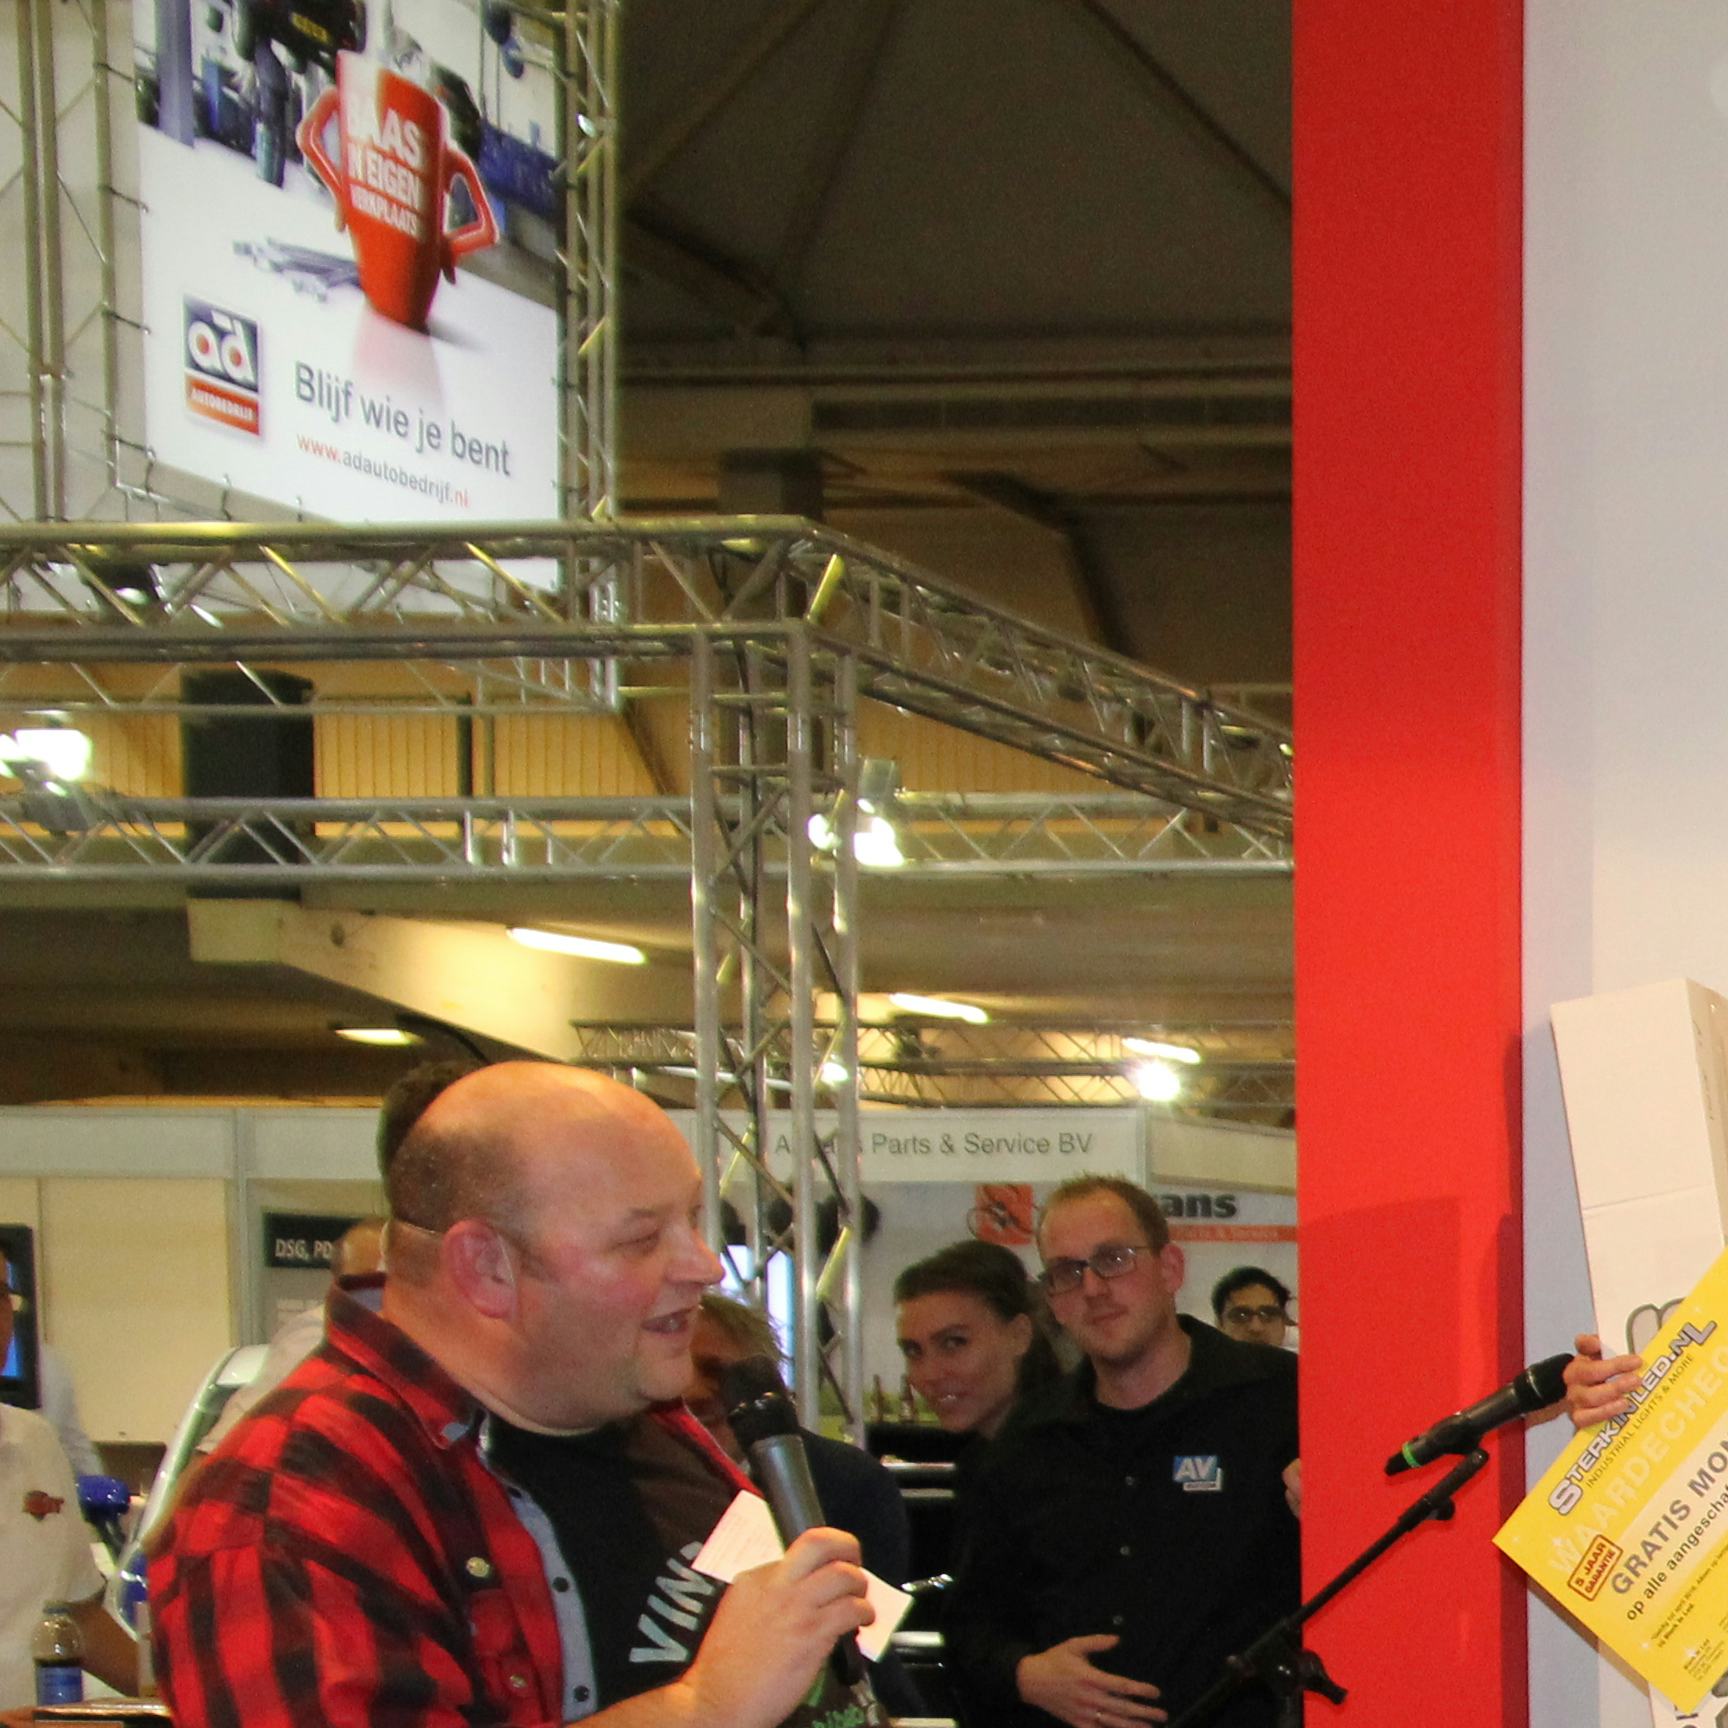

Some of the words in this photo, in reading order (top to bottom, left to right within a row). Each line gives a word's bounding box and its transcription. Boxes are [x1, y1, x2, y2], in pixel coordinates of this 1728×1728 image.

[295, 361, 353, 423] Blijf
[361, 396, 408, 438] wie
[416, 410, 441, 453] je
[451, 422, 511, 476] bent
[297, 434, 469, 508] www.adautobedrijf.nl
[872, 1133, 931, 1155] Parts
[940, 1134, 955, 1155] &
[964, 1133, 1050, 1155] Service
[1059, 1133, 1093, 1155] BV
[1154, 1192, 1238, 1219] ans
[275, 1239, 310, 1261] DSG,
[1174, 1456, 1217, 1482] AV
[1609, 1497, 1692, 1596] GRATIS
[1625, 1597, 1646, 1622] op
[1643, 1570, 1668, 1602] alle
